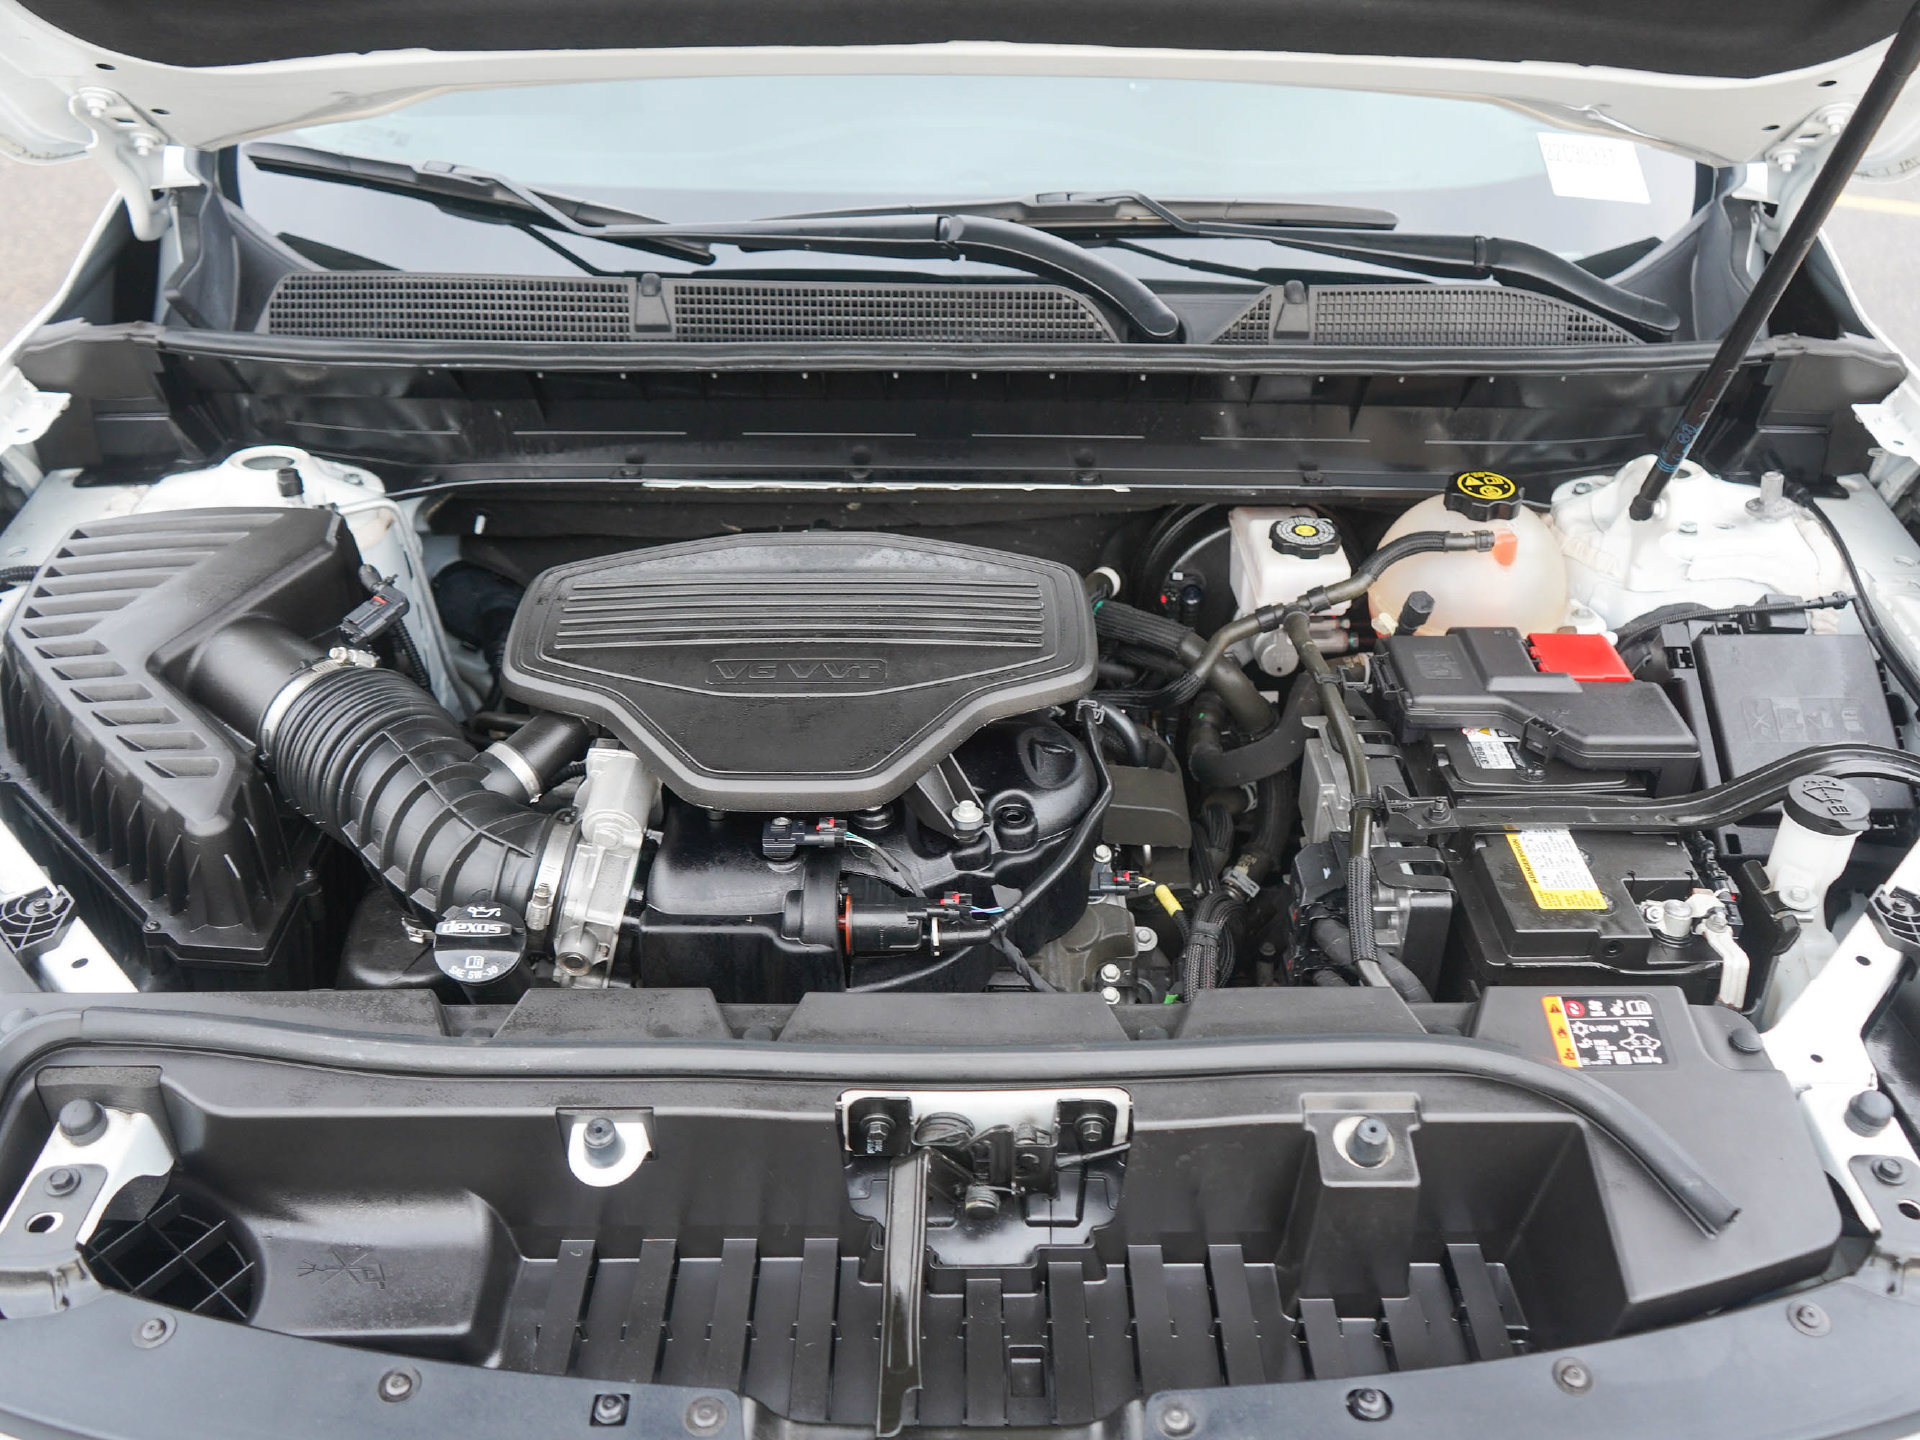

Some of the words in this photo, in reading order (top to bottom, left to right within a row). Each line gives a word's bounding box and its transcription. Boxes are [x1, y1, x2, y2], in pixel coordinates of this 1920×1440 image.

[715, 663, 777, 679] V6
[787, 663, 880, 679] VVT
[441, 921, 502, 934] dexos
[448, 965, 467, 979] SAE
